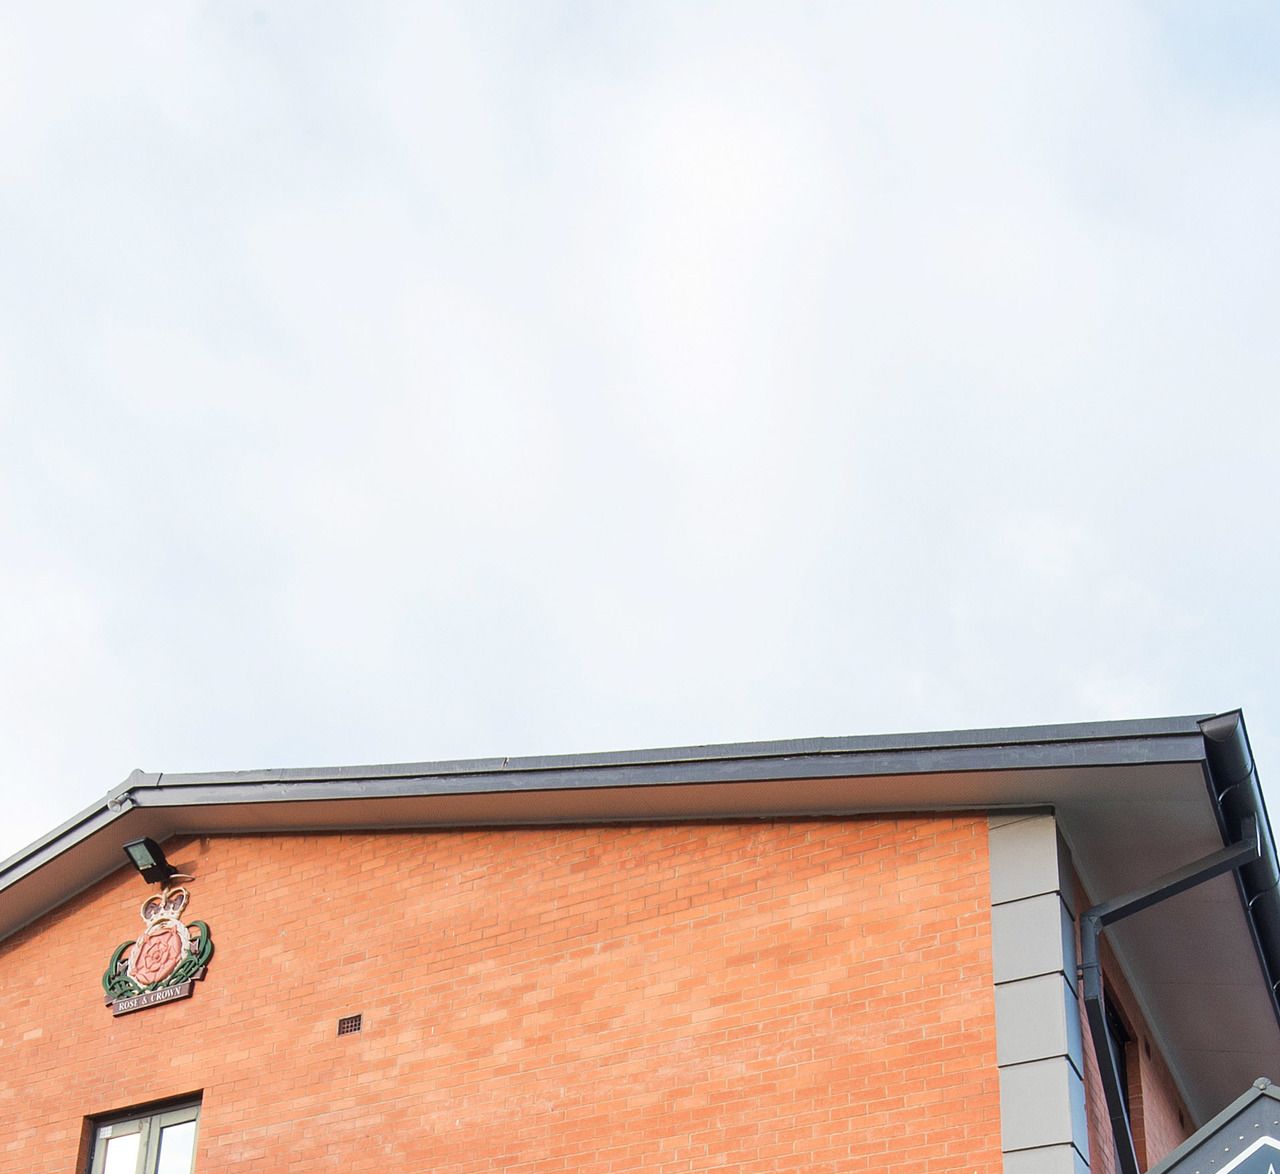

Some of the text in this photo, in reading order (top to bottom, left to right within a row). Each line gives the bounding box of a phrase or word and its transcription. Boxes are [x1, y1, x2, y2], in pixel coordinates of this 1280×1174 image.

[118, 986, 182, 1011] ROSE & CROWN
